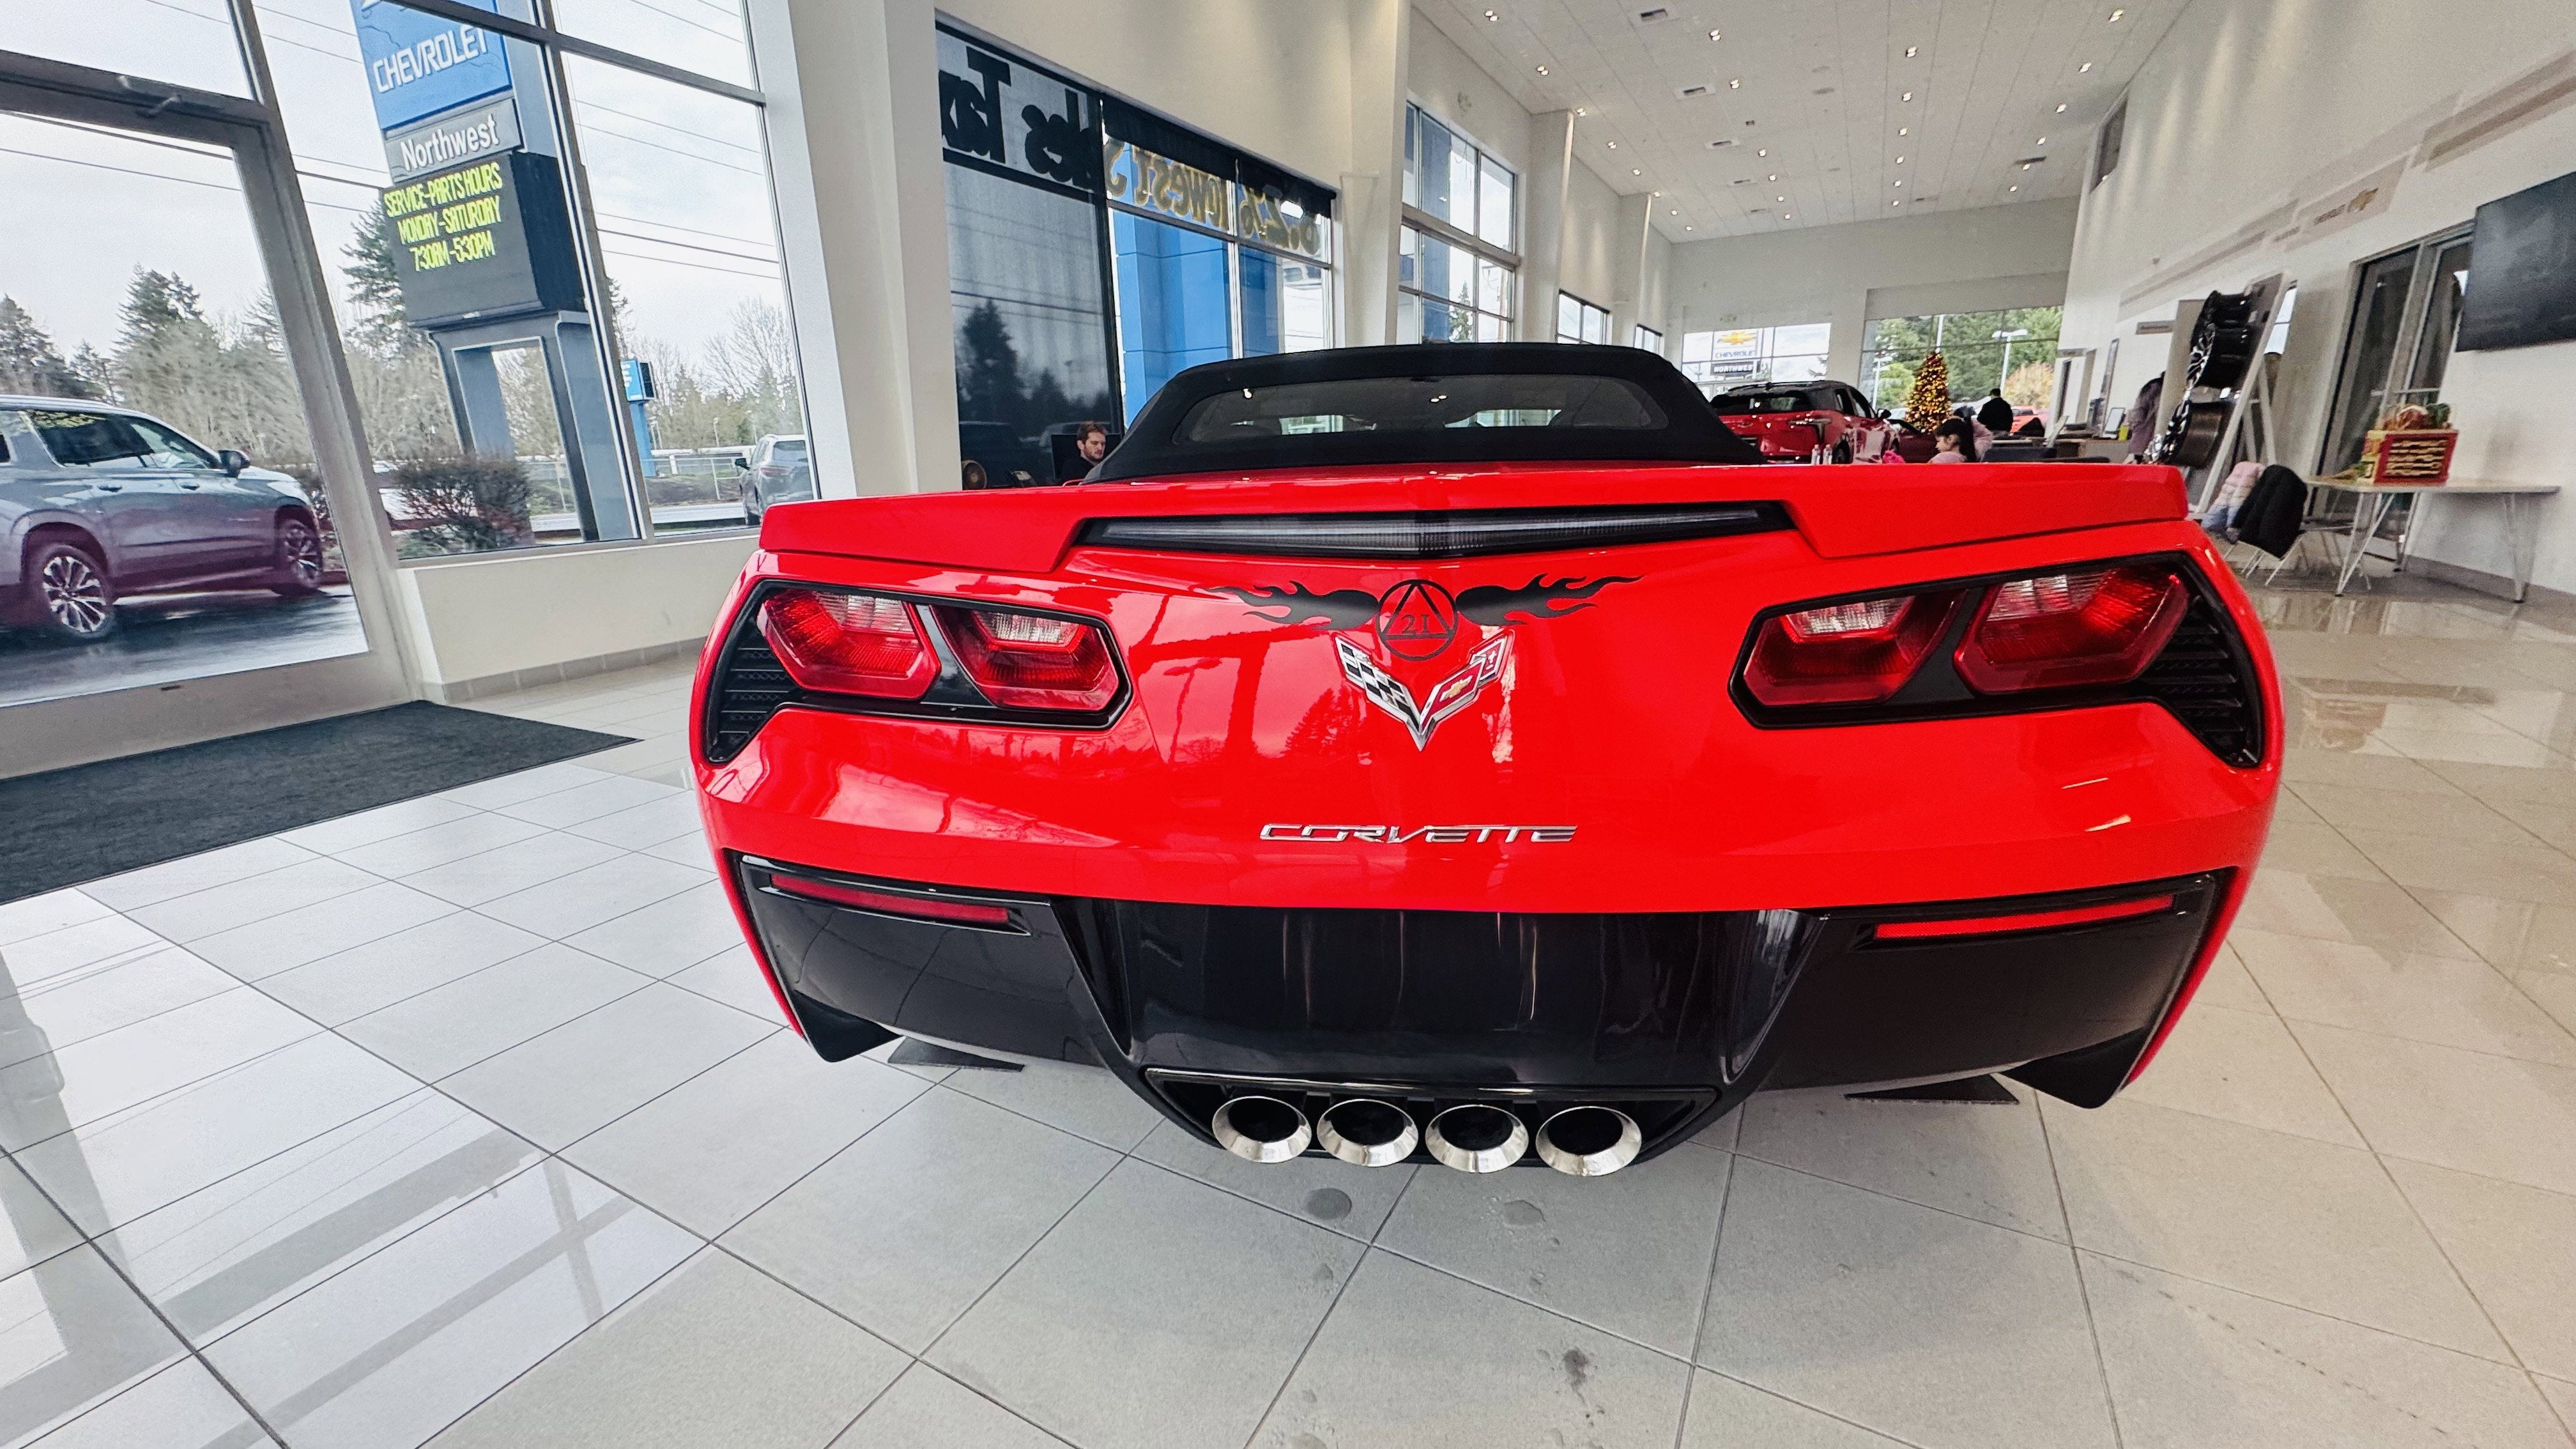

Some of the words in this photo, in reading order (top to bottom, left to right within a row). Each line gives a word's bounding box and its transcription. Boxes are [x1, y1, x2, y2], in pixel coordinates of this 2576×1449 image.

[373, 24, 488, 93] CHEVROLET
[400, 113, 500, 172] Northwest
[462, 162, 503, 197] HOURS
[1713, 364, 1754, 373] NORTHWES
[1401, 614, 1432, 636] 21
[1259, 824, 1579, 843] CORVETTE
